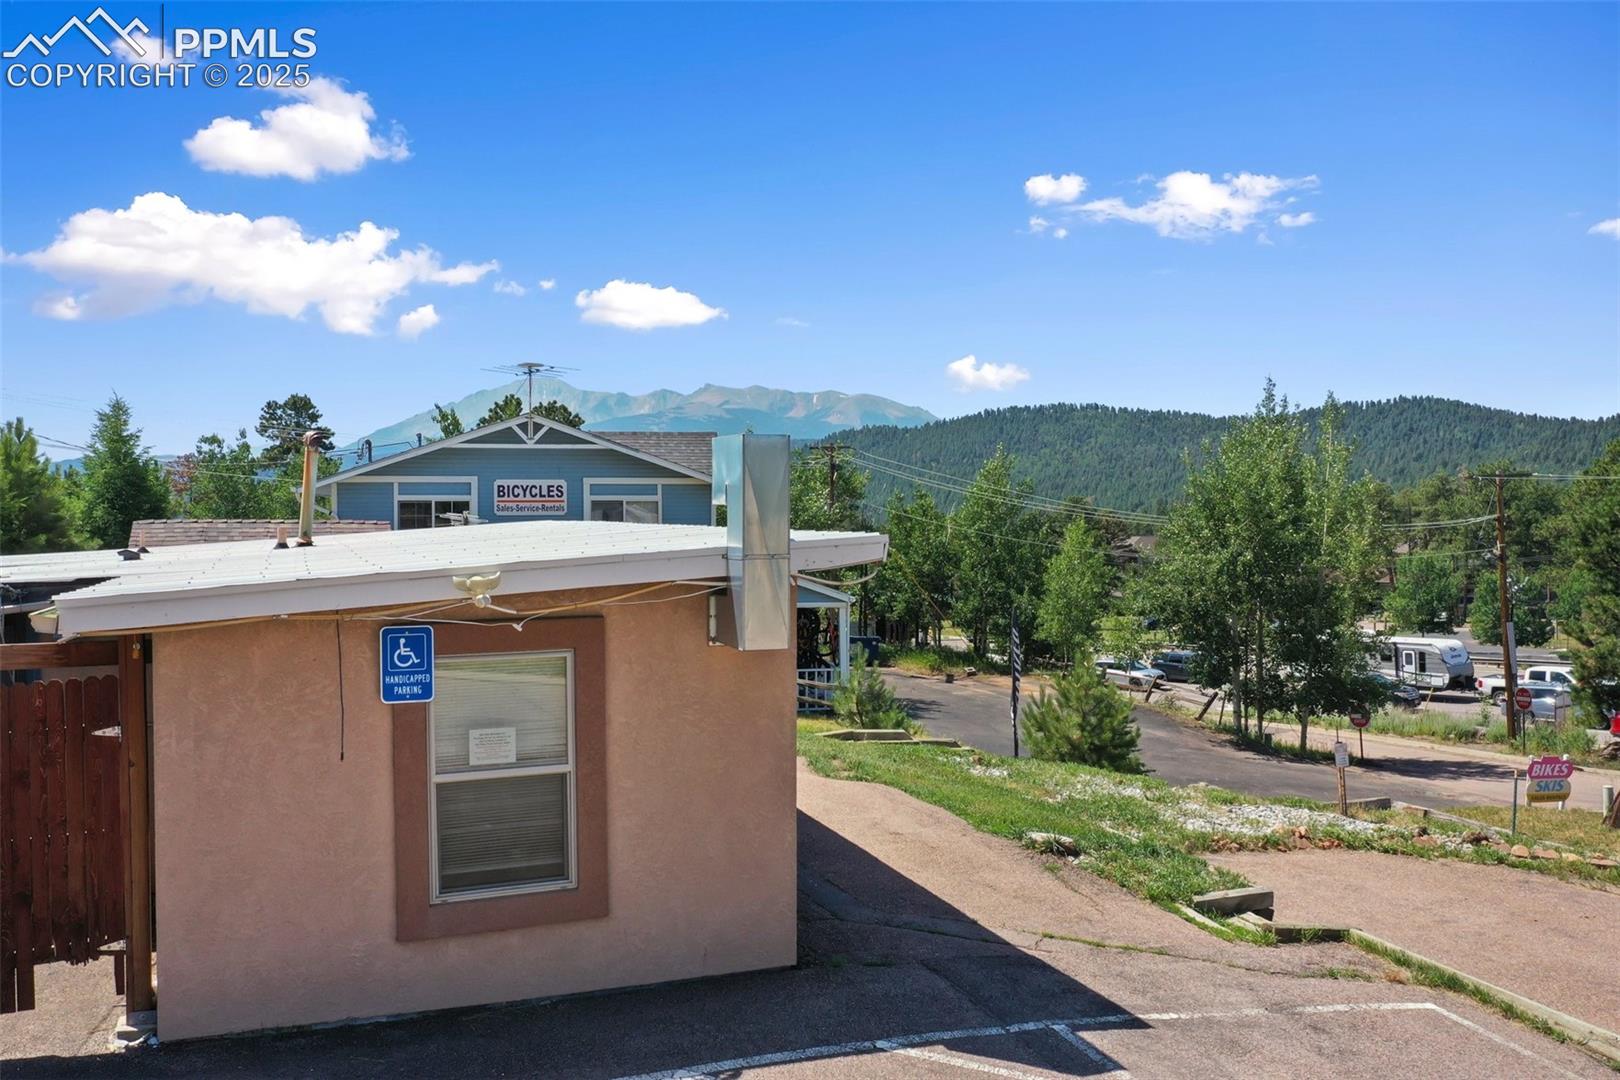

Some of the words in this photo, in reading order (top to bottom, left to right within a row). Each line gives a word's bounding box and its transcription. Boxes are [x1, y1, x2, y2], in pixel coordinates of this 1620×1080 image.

[497, 484, 564, 498] BICYCLES
[496, 504, 565, 512] Sales-Service-Rentals
[385, 674, 430, 684] HANDICAPPED
[394, 685, 422, 695] PARKING
[1531, 763, 1569, 777] BIKES
[1536, 780, 1564, 792] SKIS
